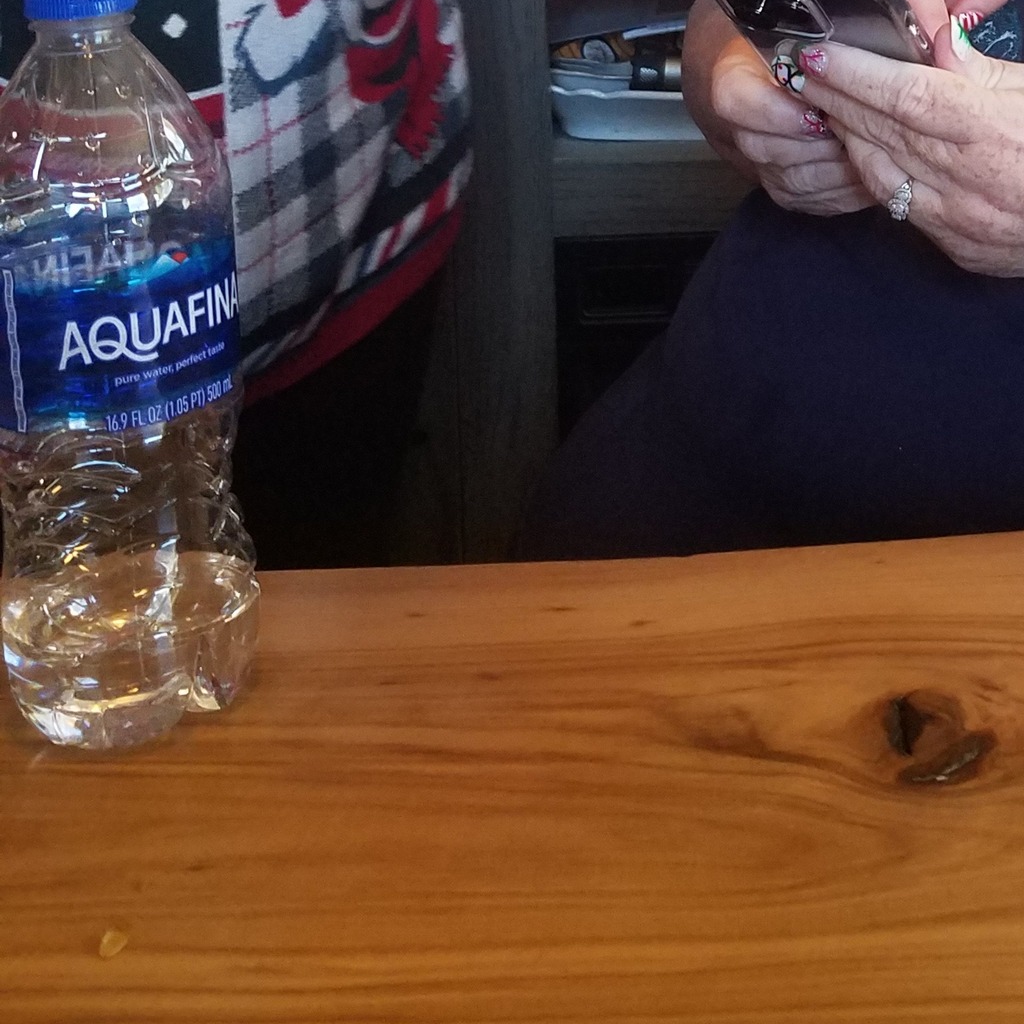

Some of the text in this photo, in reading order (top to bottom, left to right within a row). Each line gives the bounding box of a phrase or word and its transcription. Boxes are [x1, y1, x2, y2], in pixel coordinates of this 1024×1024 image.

[58, 270, 239, 371] AQUAFINA
[114, 374, 140, 387] pure
[175, 351, 207, 372] perfect
[106, 412, 128, 432] 16.9
[131, 410, 146, 427] FL
[148, 404, 162, 423] OZ
[165, 395, 189, 421] (1.05
[190, 387, 206, 409] PT)
[207, 380, 222, 402] 500
